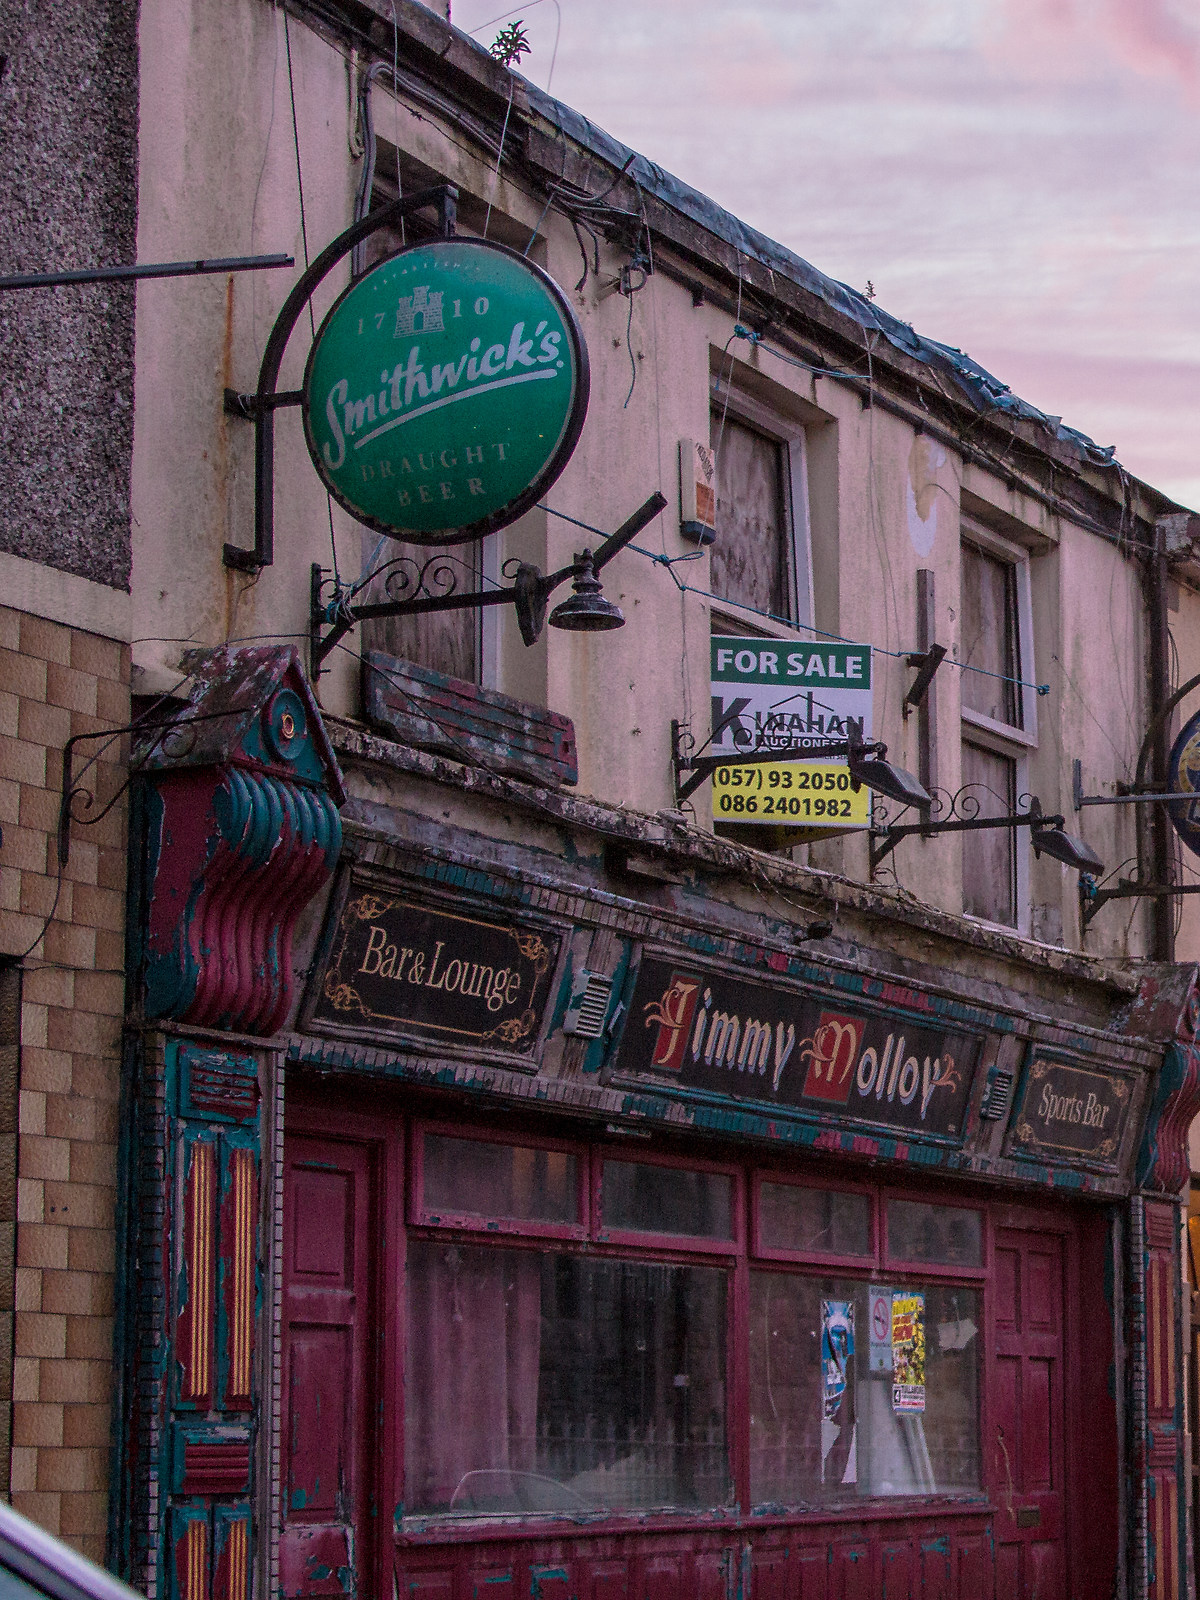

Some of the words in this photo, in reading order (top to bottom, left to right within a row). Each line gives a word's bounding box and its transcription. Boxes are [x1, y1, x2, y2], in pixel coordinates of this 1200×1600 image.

[322, 320, 563, 471] Smithwick's
[360, 442, 511, 482] DRAUGHT
[400, 477, 487, 507] BEER
[717, 648, 779, 675] FOR
[786, 652, 863, 679] SALE
[711, 691, 865, 746] KINAHAN
[711, 768, 763, 790] (057)
[768, 770, 793, 789] 93
[798, 772, 851, 791] 2050
[719, 794, 758, 813] 086
[762, 796, 852, 817] 2401982
[645, 980, 795, 1091] Jimmy
[801, 1020, 942, 1120] Molloy
[1037, 1083, 1083, 1126] Sports
[1082, 1092, 1110, 1129] Bar
